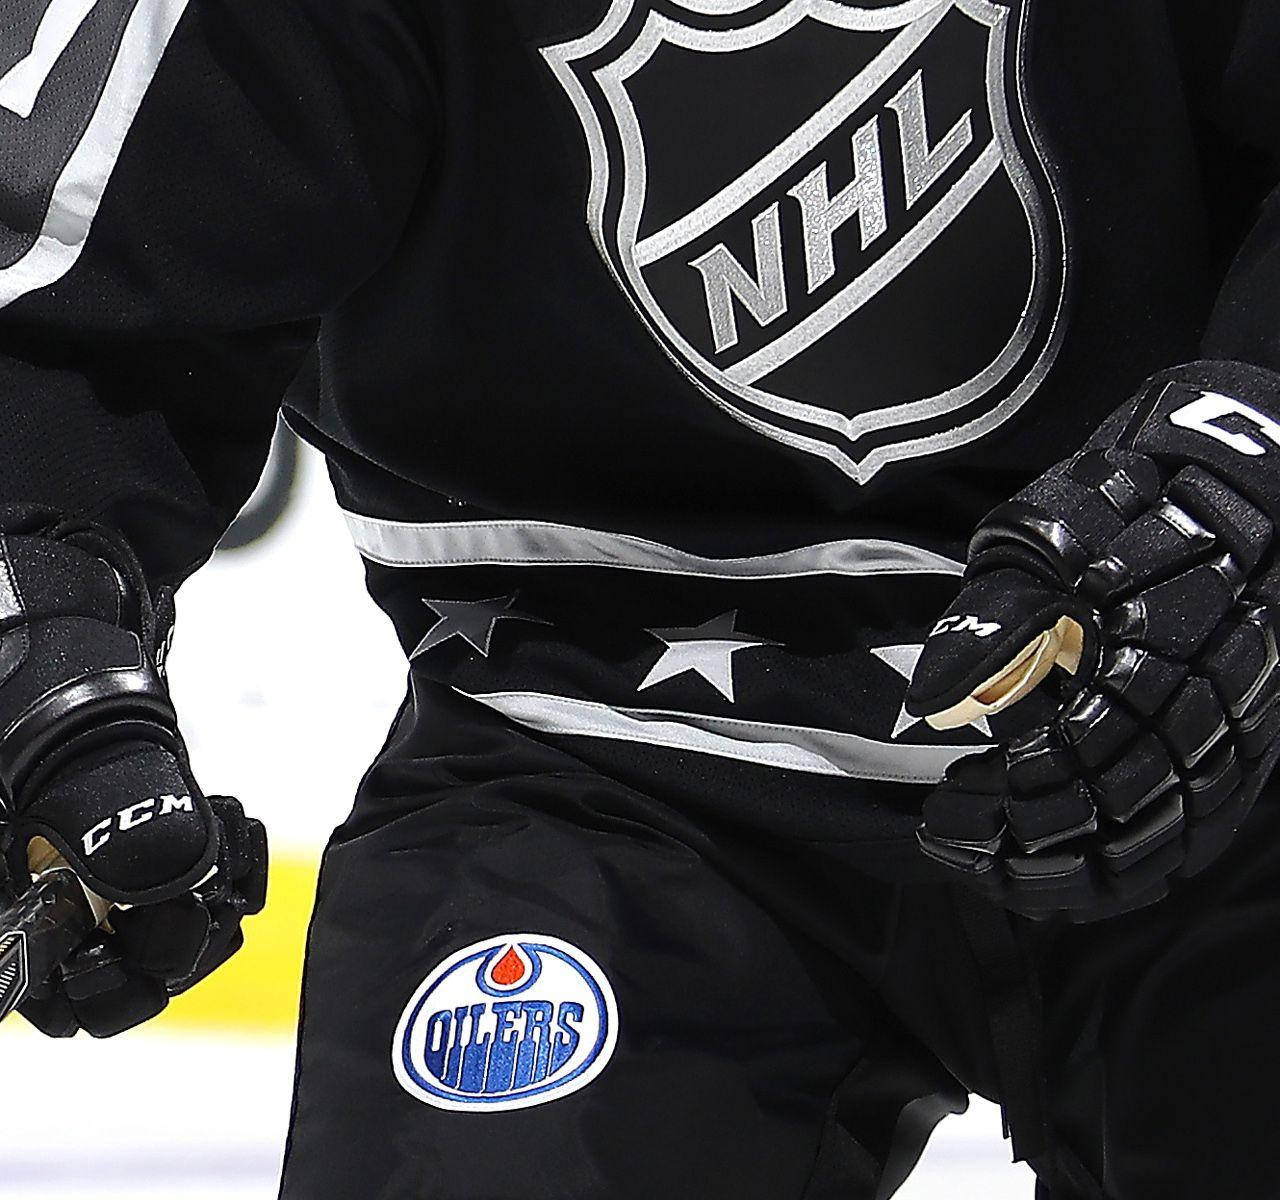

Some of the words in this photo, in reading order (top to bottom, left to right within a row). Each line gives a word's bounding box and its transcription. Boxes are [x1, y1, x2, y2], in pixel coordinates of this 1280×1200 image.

[688, 69, 974, 354] NHL
[929, 615, 1002, 637] CM
[81, 794, 194, 857] CCM
[423, 1000, 585, 1095] OILERS
